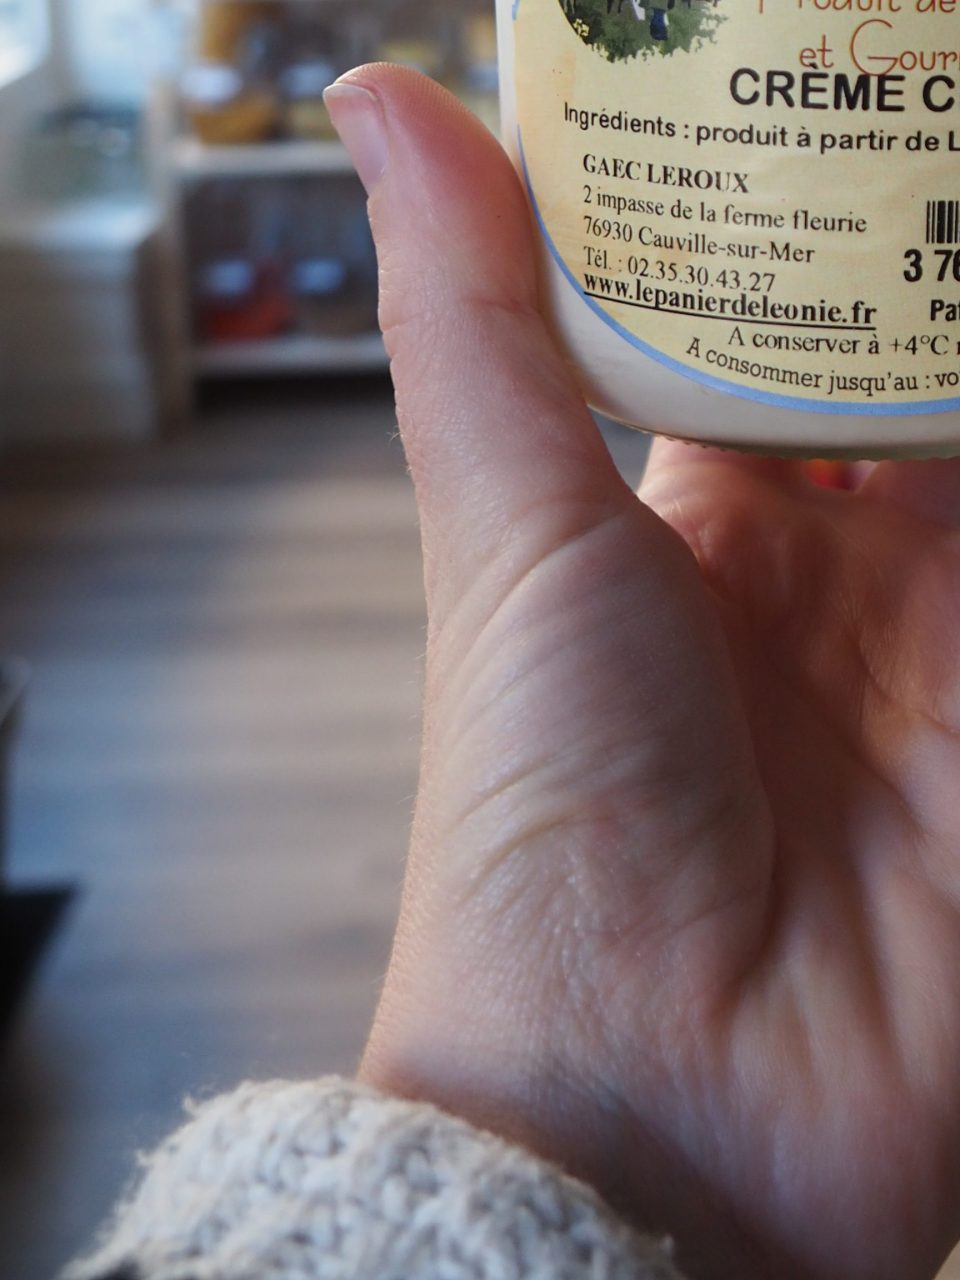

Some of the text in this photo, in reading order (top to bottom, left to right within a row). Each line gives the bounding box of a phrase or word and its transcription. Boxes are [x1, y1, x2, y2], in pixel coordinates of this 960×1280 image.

[799, 34, 834, 69] et
[730, 62, 905, 113] CRÈME
[564, 102, 676, 138] Ingrédients
[696, 124, 788, 146] produit
[796, 126, 811, 148] à
[820, 129, 898, 154] partir
[905, 131, 940, 151] de
[582, 153, 750, 194] GAEC LEROUX
[583, 185, 868, 233] 2 impasse de la ferme fleurie
[583, 216, 816, 263] 76930 Cauville-sur-Mer
[584, 246, 611, 270] Tél.
[627, 256, 776, 293] 02.35.30.43.27
[903, 248, 923, 282] 3
[584, 274, 877, 325] www.lepanierdeleonie.fr
[686, 337, 701, 358] A
[706, 348, 824, 389] consommer
[728, 326, 746, 346] A
[751, 331, 861, 354] conserver
[868, 333, 880, 355] à
